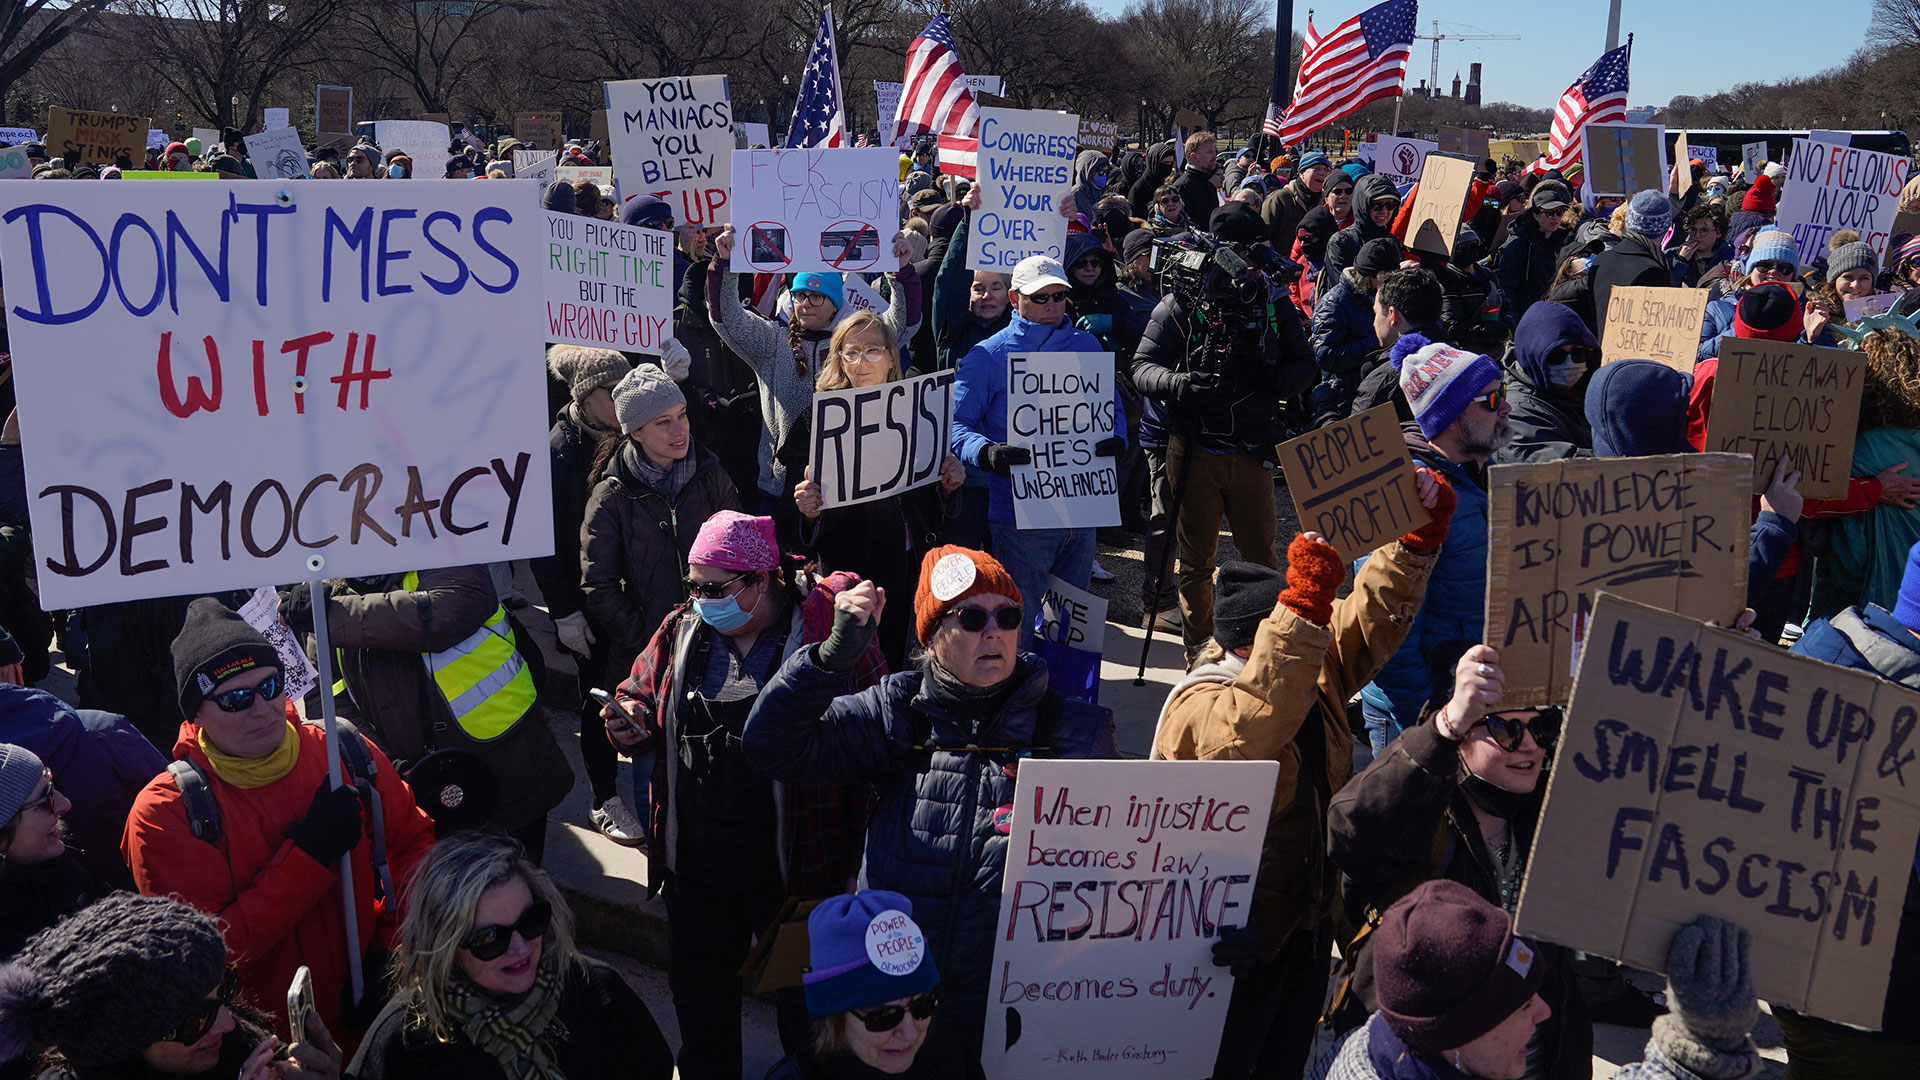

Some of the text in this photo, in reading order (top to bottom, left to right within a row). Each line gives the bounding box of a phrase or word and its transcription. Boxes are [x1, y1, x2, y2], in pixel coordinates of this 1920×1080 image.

[642, 78, 696, 104] YOU
[67, 112, 138, 133] TRUMP'S
[75, 128, 121, 145] MUSK
[981, 118, 1076, 161] CONGRESS
[1079, 134, 1115, 147] WORKERS
[652, 133, 703, 157] YOU
[1789, 141, 1825, 183] NO
[642, 154, 714, 184] BLEW
[1428, 158, 1447, 191] NO
[783, 178, 898, 220] FASCISM
[1001, 185, 1053, 212] YOUR
[1811, 187, 1879, 230] IN OUR
[547, 216, 667, 257] YOU PICKED THE
[3, 189, 520, 324] DON'T MESS
[550, 243, 665, 288] RIGHT TIME
[579, 280, 637, 308] BUT THE
[624, 312, 667, 349] GUY
[1608, 296, 1698, 331] CIVIL SERVANTS
[1616, 327, 1674, 354] SERVE ALL
[157, 331, 393, 418] WITH
[1010, 358, 1100, 394] FOLLOW
[1731, 351, 1859, 390] TAKE AWAY
[1012, 400, 1114, 437] CHECKS
[1753, 395, 1834, 433] ELON'S
[813, 372, 955, 502] RESIST
[1032, 439, 1092, 469] HE'S
[1295, 415, 1385, 489] PEOPLE
[38, 452, 531, 577] DEMOCRACY
[1316, 473, 1413, 551] PROFIT
[1515, 469, 1697, 527] KNOWLEDGE
[933, 553, 964, 581] POWER
[936, 564, 974, 593] PEOPLE
[1608, 619, 1917, 788] WAKE UP &
[1573, 719, 1880, 853] SMELL THE
[1034, 786, 1251, 843] When injustice
[1027, 830, 1209, 880] becomes law,
[1606, 807, 1879, 947] FASCISM
[871, 915, 907, 935] POWER
[1006, 875, 1251, 943] RESISTANCE
[876, 936, 916, 958] PEOPLE
[880, 952, 920, 973] DEMOCRACY
[1000, 961, 1215, 1010] becomes duty.
[1057, 1048, 1088, 1063] Ruth
